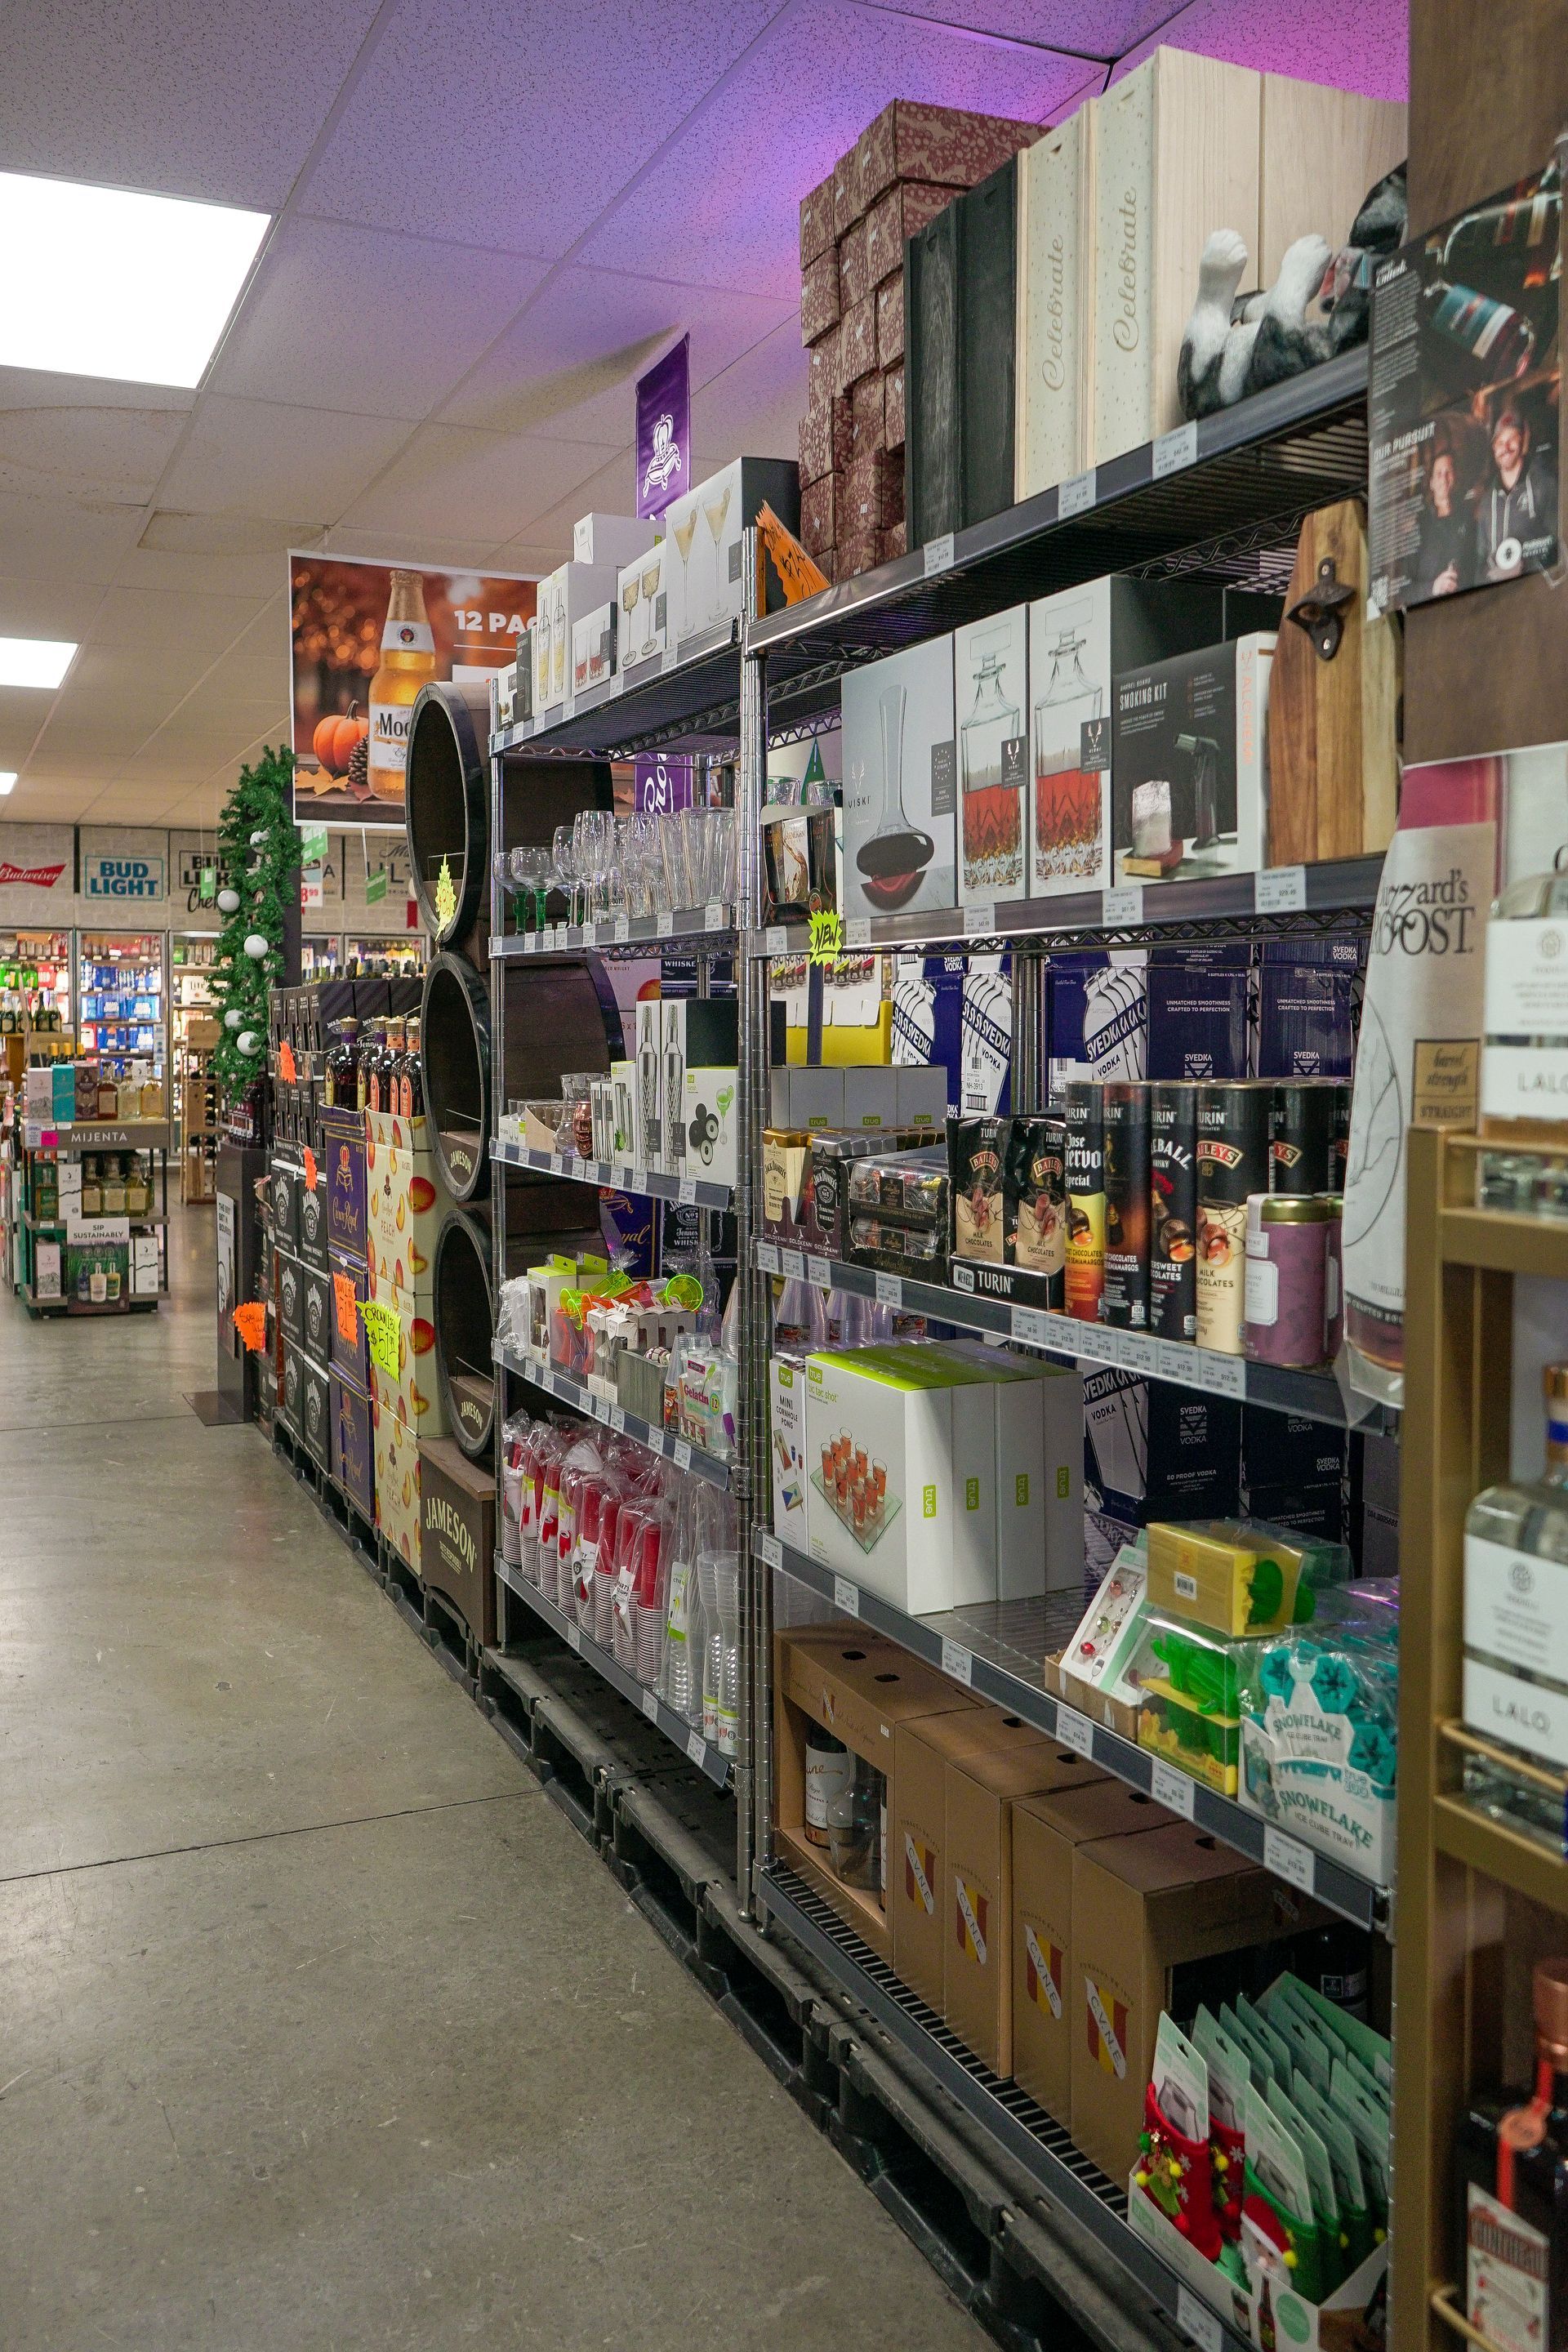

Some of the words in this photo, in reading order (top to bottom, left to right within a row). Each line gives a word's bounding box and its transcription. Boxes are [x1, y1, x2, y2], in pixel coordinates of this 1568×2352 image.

[1112, 185, 1138, 353] Celebrate
[1042, 234, 1064, 392] Celebrate
[1392, 421, 1437, 453] PURSUIT
[453, 610, 483, 631] 12
[1120, 687, 1152, 710] SMOKING
[1154, 682, 1168, 702] KIT
[848, 795, 871, 809] VISKI
[0, 866, 60, 881] Budweiser
[100, 862, 149, 878] BUD
[91, 879, 158, 896] LIGHT
[815, 919, 839, 950] NEW
[944, 962, 964, 972] VODKA
[901, 1018, 932, 1055] SVEDKA
[982, 1021, 1012, 1057] SVEDKA
[1086, 1022, 1122, 1062] SVEDKA
[982, 1047, 1001, 1071] VODKA
[1098, 1054, 1121, 1077] VODKA
[1185, 1054, 1213, 1062] SVEDKA
[1065, 1108, 1089, 1120] URIN
[1152, 1111, 1175, 1124] URIN
[1198, 1111, 1226, 1125] URIN
[71, 1131, 127, 1143] MIJENTA
[1067, 1133, 1085, 1150] Jose
[973, 1152, 999, 1168] BAILEYS
[1152, 1138, 1194, 1170] EBALL
[450, 1150, 472, 1175] JAMESON
[73, 1231, 123, 1239] SUSTAINABLY
[381, 1219, 395, 1238] PEACH
[621, 1224, 651, 1245] yal
[675, 1227, 699, 1236] Tennes
[764, 1233, 787, 1243] GOLDKENN
[789, 1237, 813, 1248] GOLDKENN
[965, 1238, 992, 1248] CHOCOLATES
[1027, 1245, 1054, 1257] CHOCOLATES
[1073, 1248, 1102, 1258] CHOCOLATES
[1152, 1262, 1183, 1272] ERSWEET
[978, 1271, 1012, 1294] TURIN
[1152, 1271, 1182, 1281] COLATES
[780, 1371, 791, 1383] true
[810, 1369, 822, 1381] true
[684, 1384, 710, 1405] Gelatin
[1084, 1371, 1118, 1404] VEDKA
[711, 1397, 719, 1410] 12
[779, 1395, 793, 1410] MINI
[825, 1390, 837, 1402] shot
[461, 1401, 483, 1431] JAMESON
[776, 1405, 798, 1422] CORNHOLE
[1091, 1404, 1117, 1421] VODKA
[1180, 1405, 1207, 1414] SVEDKA
[781, 1418, 794, 1429] PONG
[1288, 1423, 1313, 1432] VODKA
[1180, 1435, 1207, 1446] VODKA
[1316, 1457, 1339, 1465] SVEDKA
[1316, 1463, 1340, 1472] VODKA
[1197, 1469, 1217, 1477] VODKA
[1296, 1510, 1325, 1519] SMOOTHNESS
[1297, 1517, 1325, 1525] PERFECTION
[426, 1497, 475, 1573] JAMESON
[1491, 1694, 1551, 1733] LALO
[1272, 1713, 1341, 1741] SNOWFLAKE
[806, 1764, 825, 1775] une
[1279, 1789, 1374, 1849] SNOWFLAKE
[1294, 1811, 1308, 1825] ICE
[1309, 1819, 1330, 1836] CUBE
[1331, 1830, 1355, 1849] TRAY
